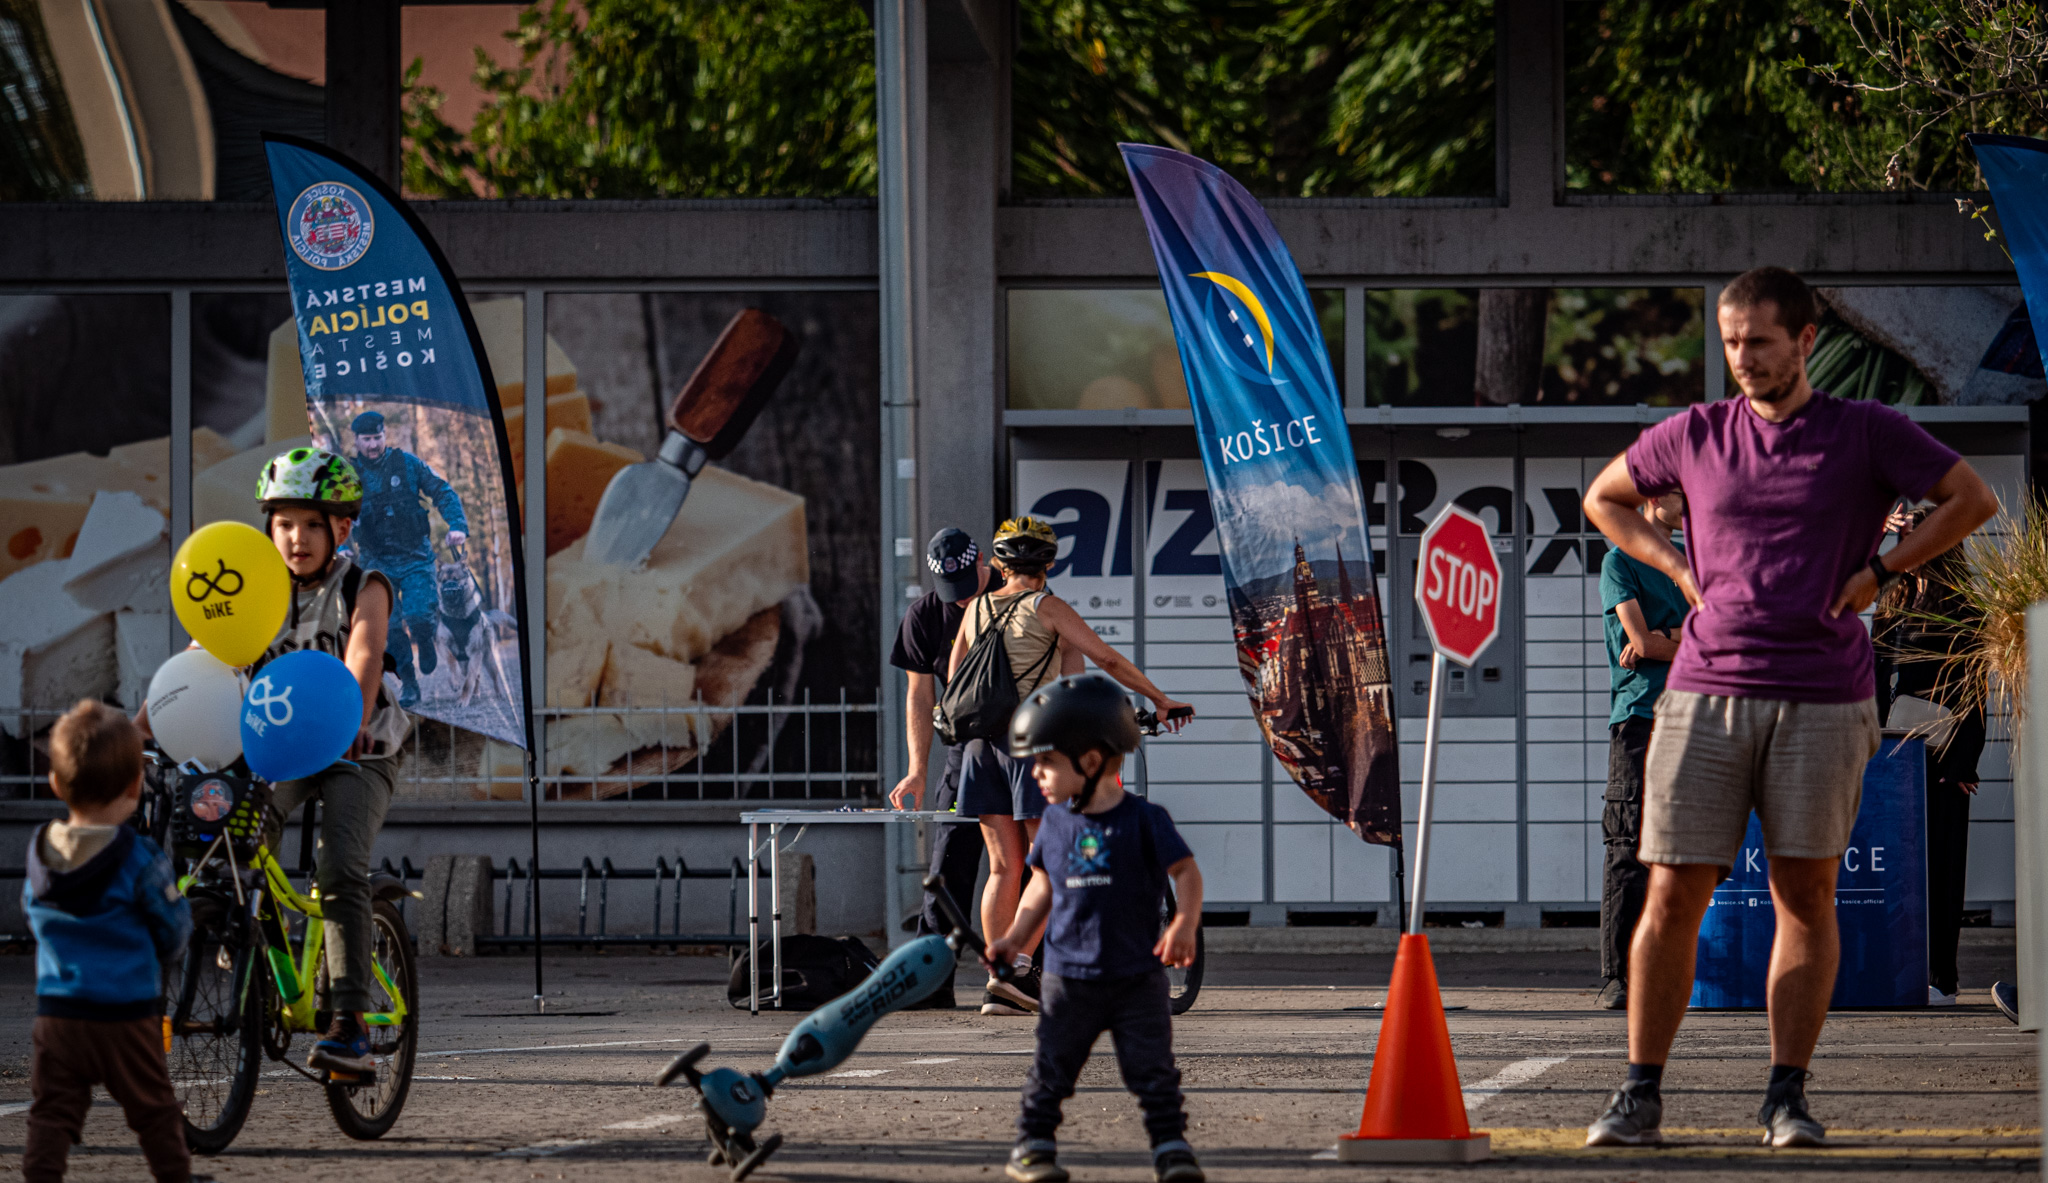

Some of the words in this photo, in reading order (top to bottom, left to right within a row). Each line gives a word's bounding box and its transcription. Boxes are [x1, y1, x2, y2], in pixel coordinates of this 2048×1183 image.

[1219, 415, 1322, 465] KOŠICE
[1425, 546, 1497, 622] STOP
[840, 960, 906, 1021] SCOOT
[871, 971, 918, 1014] RIDE
